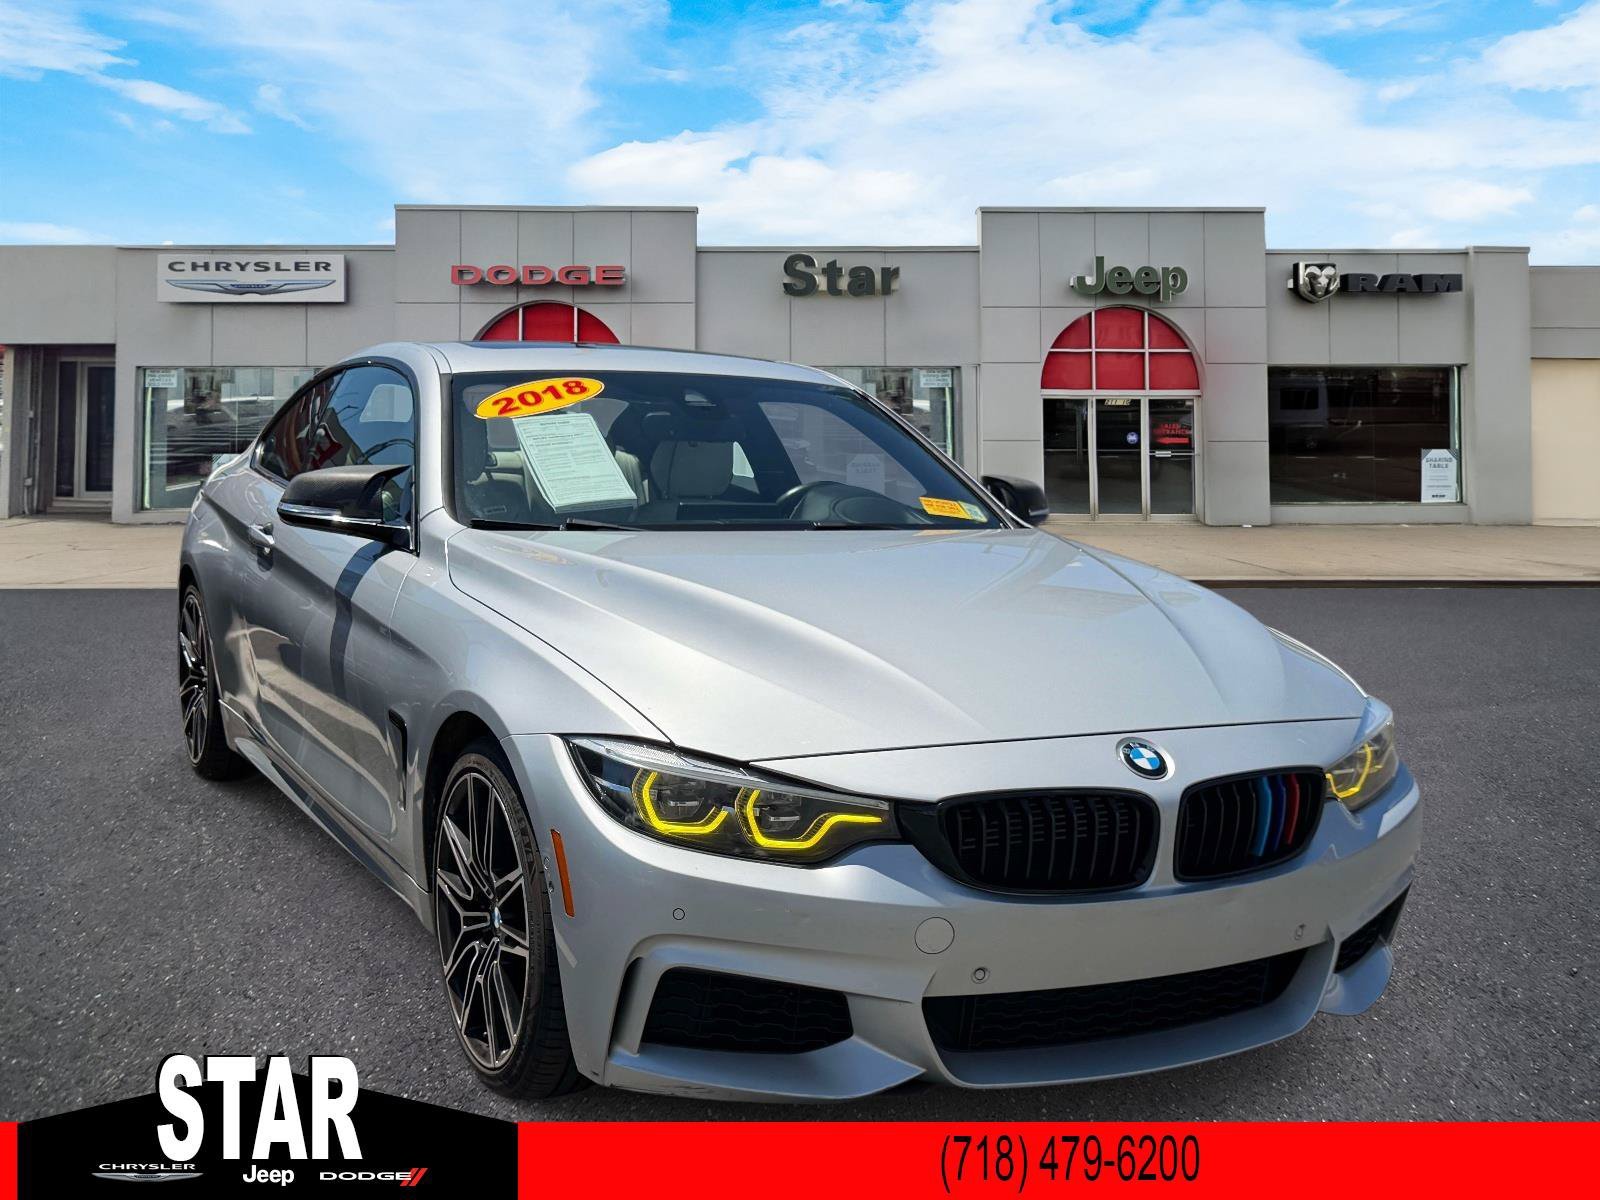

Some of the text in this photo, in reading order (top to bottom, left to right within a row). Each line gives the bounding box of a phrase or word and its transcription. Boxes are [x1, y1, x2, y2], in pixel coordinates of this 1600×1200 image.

[168, 261, 332, 272] CHRYSLER
[451, 265, 626, 285] DODGE
[783, 253, 901, 297] Star
[1070, 256, 1189, 302] Jeep
[1341, 273, 1463, 293] RAM
[491, 380, 590, 416] 2018
